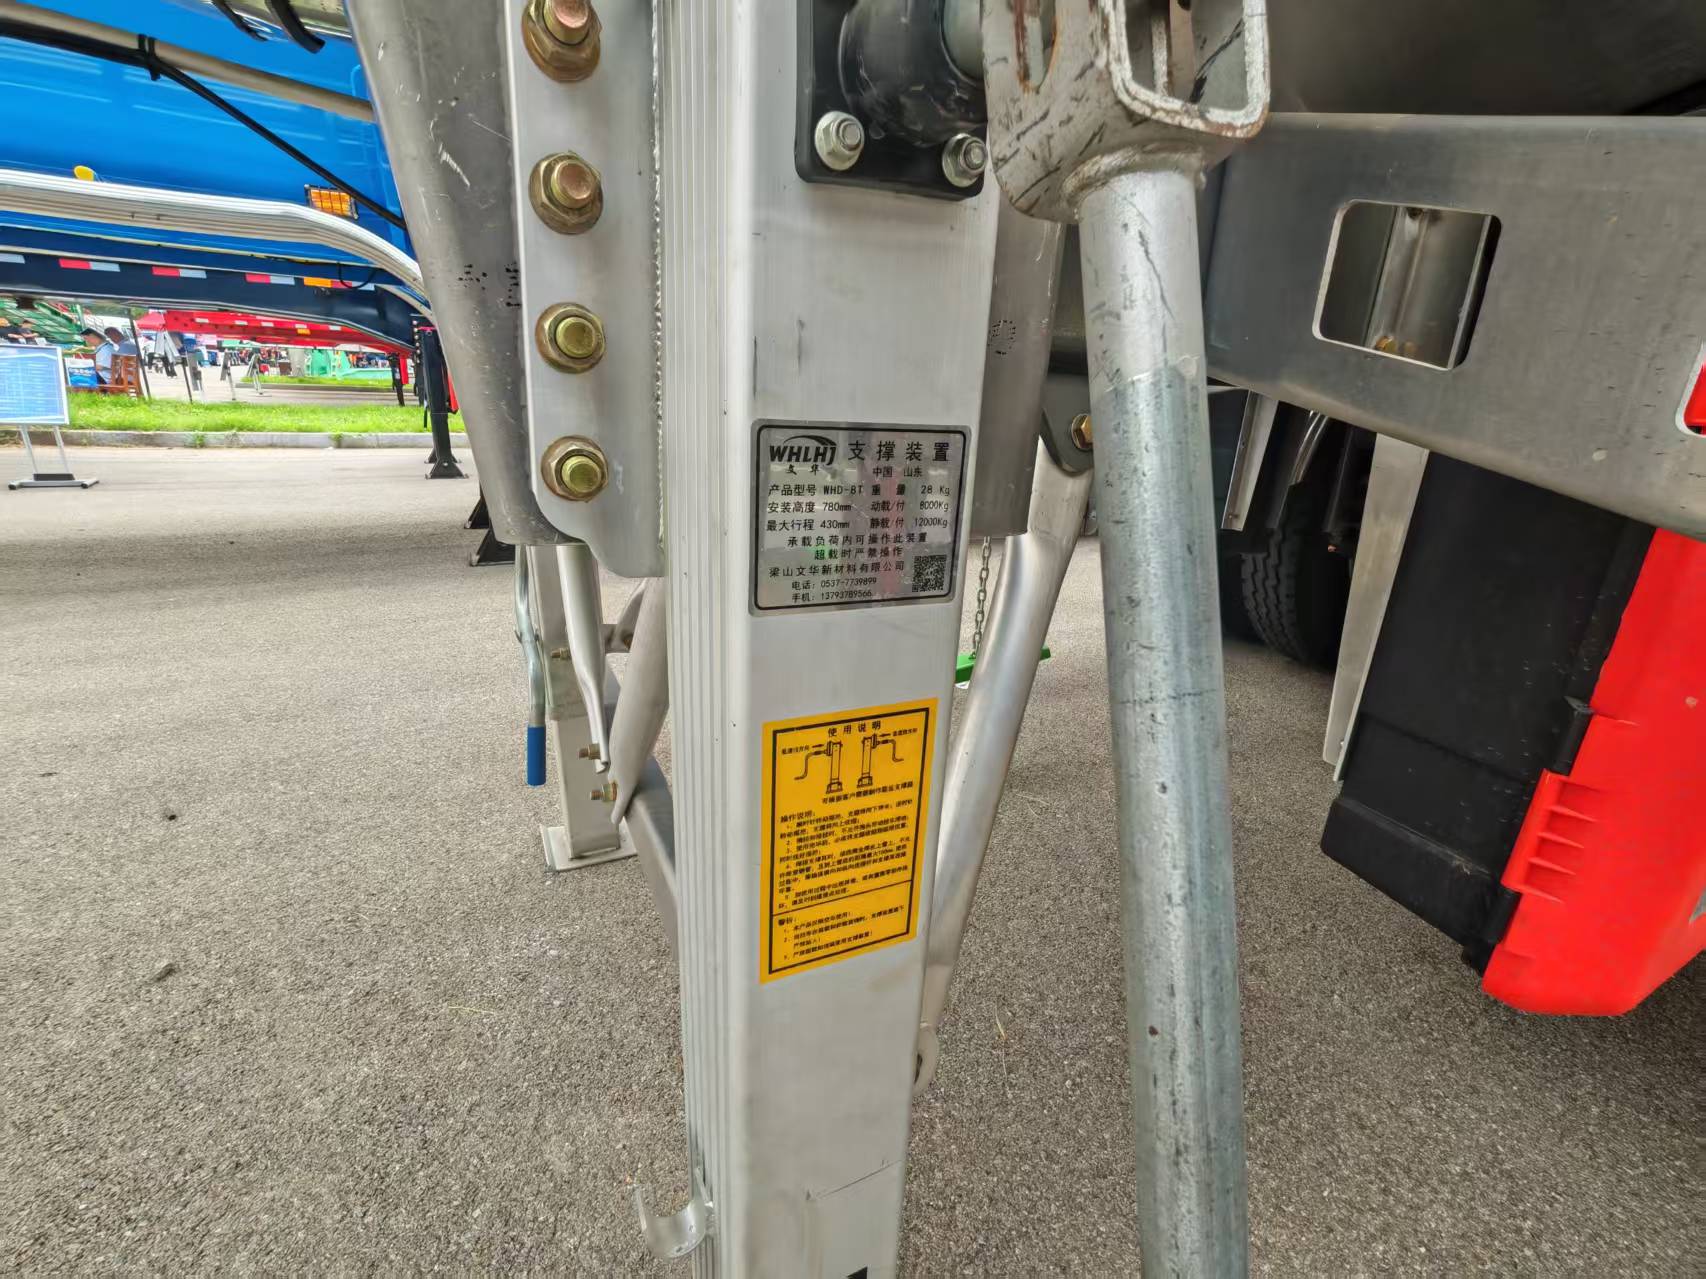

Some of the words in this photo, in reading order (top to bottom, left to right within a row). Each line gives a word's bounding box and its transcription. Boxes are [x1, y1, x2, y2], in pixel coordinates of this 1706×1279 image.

[847, 440, 950, 462] 支撑装置
[873, 466, 893, 478] 中国
[903, 466, 922, 478] 山东
[768, 484, 817, 497] 产品型号
[823, 484, 864, 496] WHD-8T
[767, 501, 816, 514] 安装高度
[823, 502, 852, 513] 780mm
[919, 500, 949, 512] 8000Kg
[766, 519, 815, 532] 最大行程
[820, 519, 850, 530] 430mm
[768, 561, 905, 578] 梁山文华新材料有限公司
